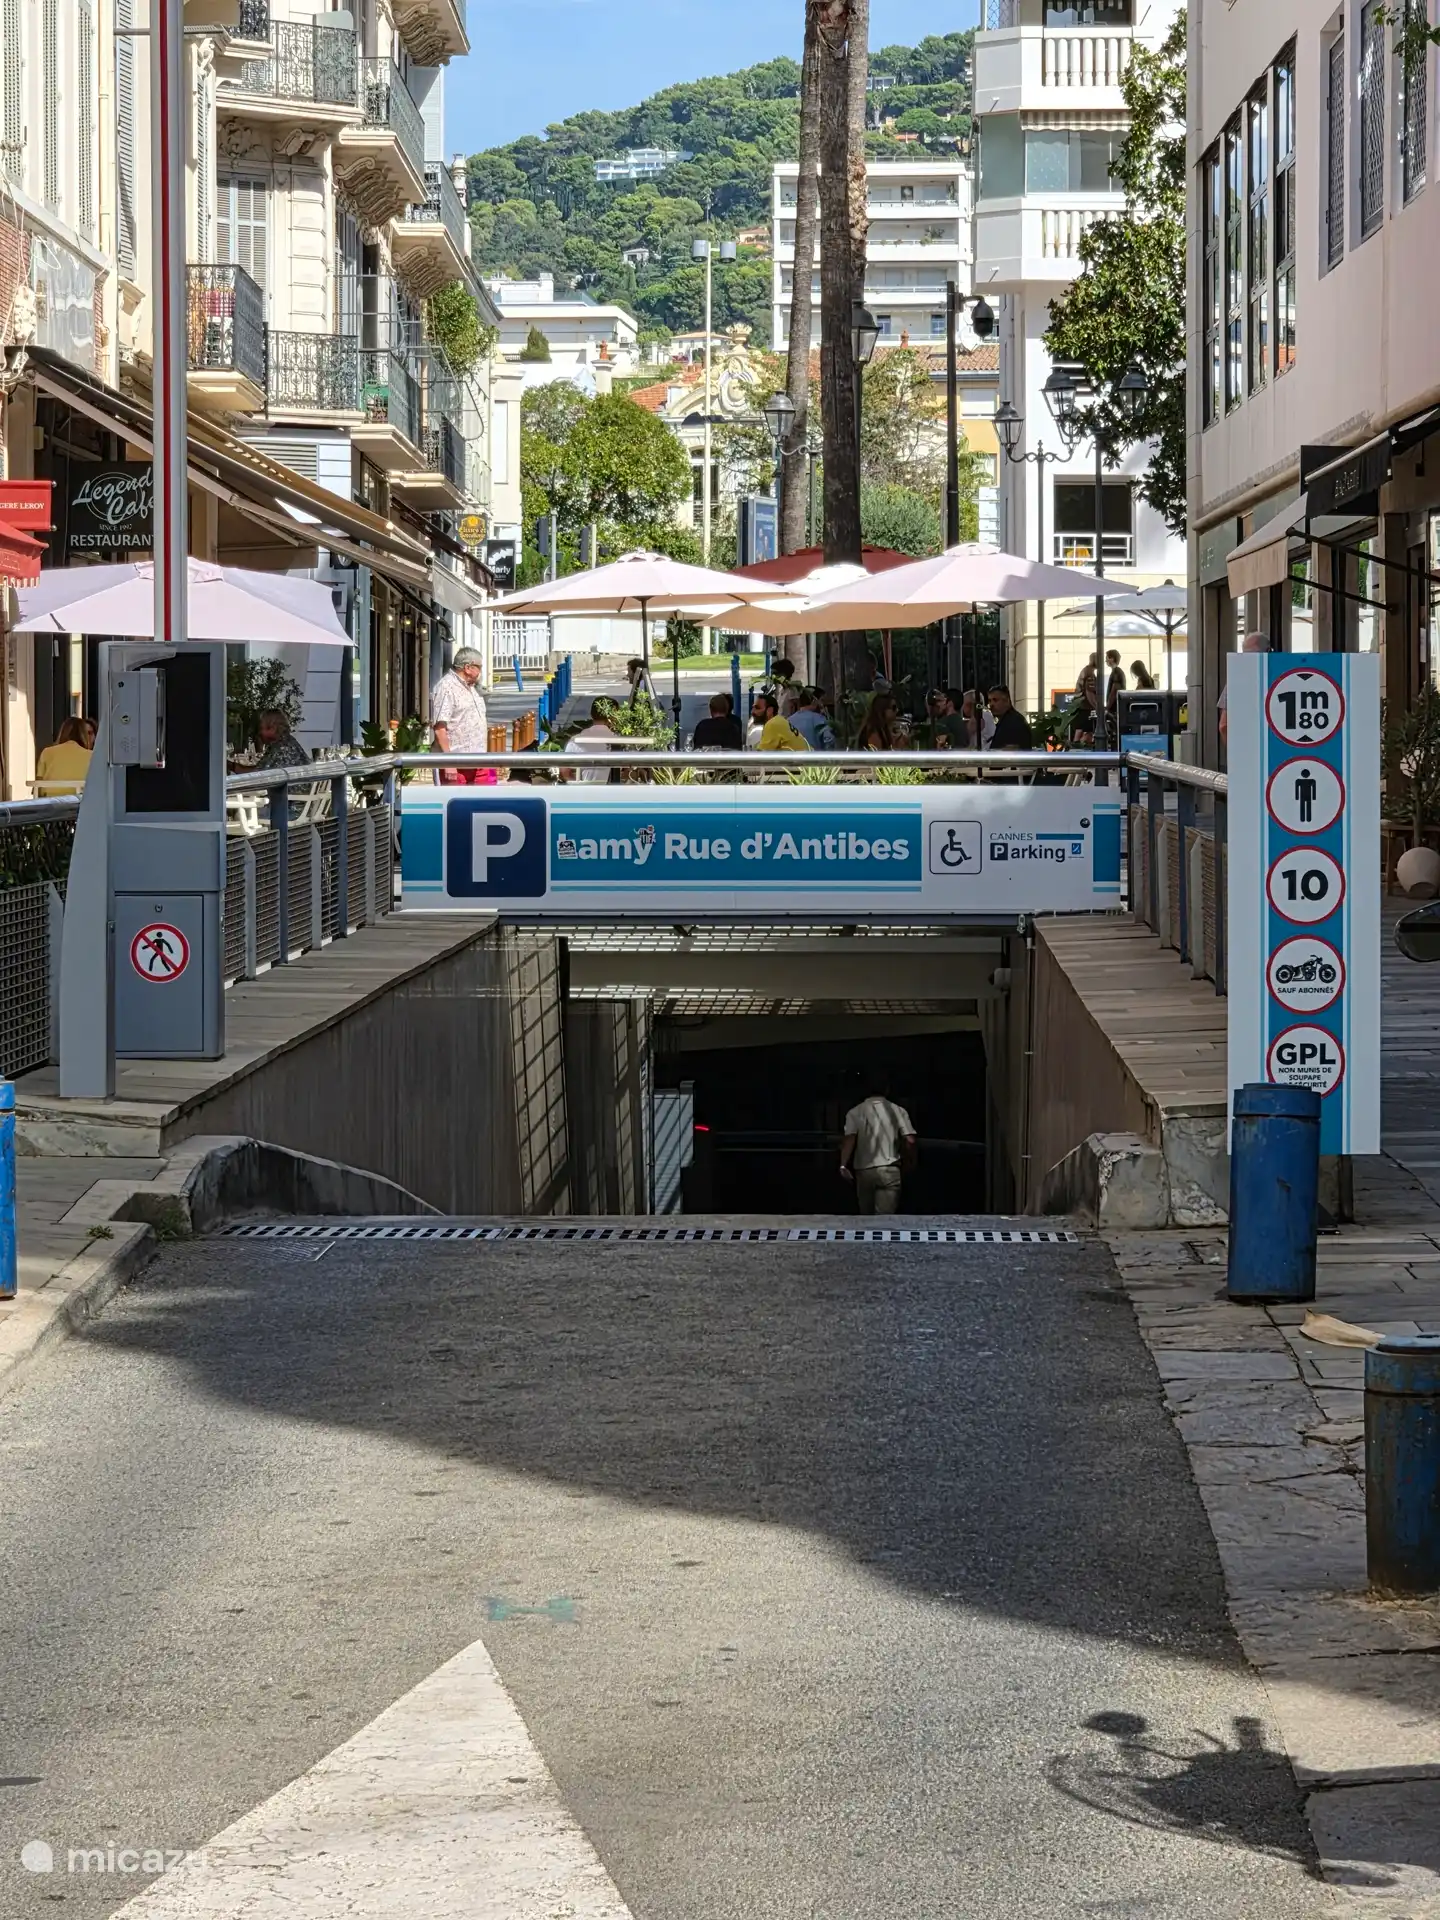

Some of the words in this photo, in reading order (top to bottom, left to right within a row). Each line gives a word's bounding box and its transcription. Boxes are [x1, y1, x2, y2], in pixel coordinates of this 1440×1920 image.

[72, 466, 154, 506] Legend
[20, 502, 45, 510] LEROY
[70, 534, 154, 547] RESTAURAN
[664, 833, 732, 860] Rue
[740, 832, 910, 861] d'Antibes
[989, 832, 1034, 841] CANNES
[472, 812, 526, 883] P
[990, 843, 1066, 863] Parking
[1298, 986, 1334, 994] ABONNÉS
[1276, 1042, 1336, 1066] GPL
